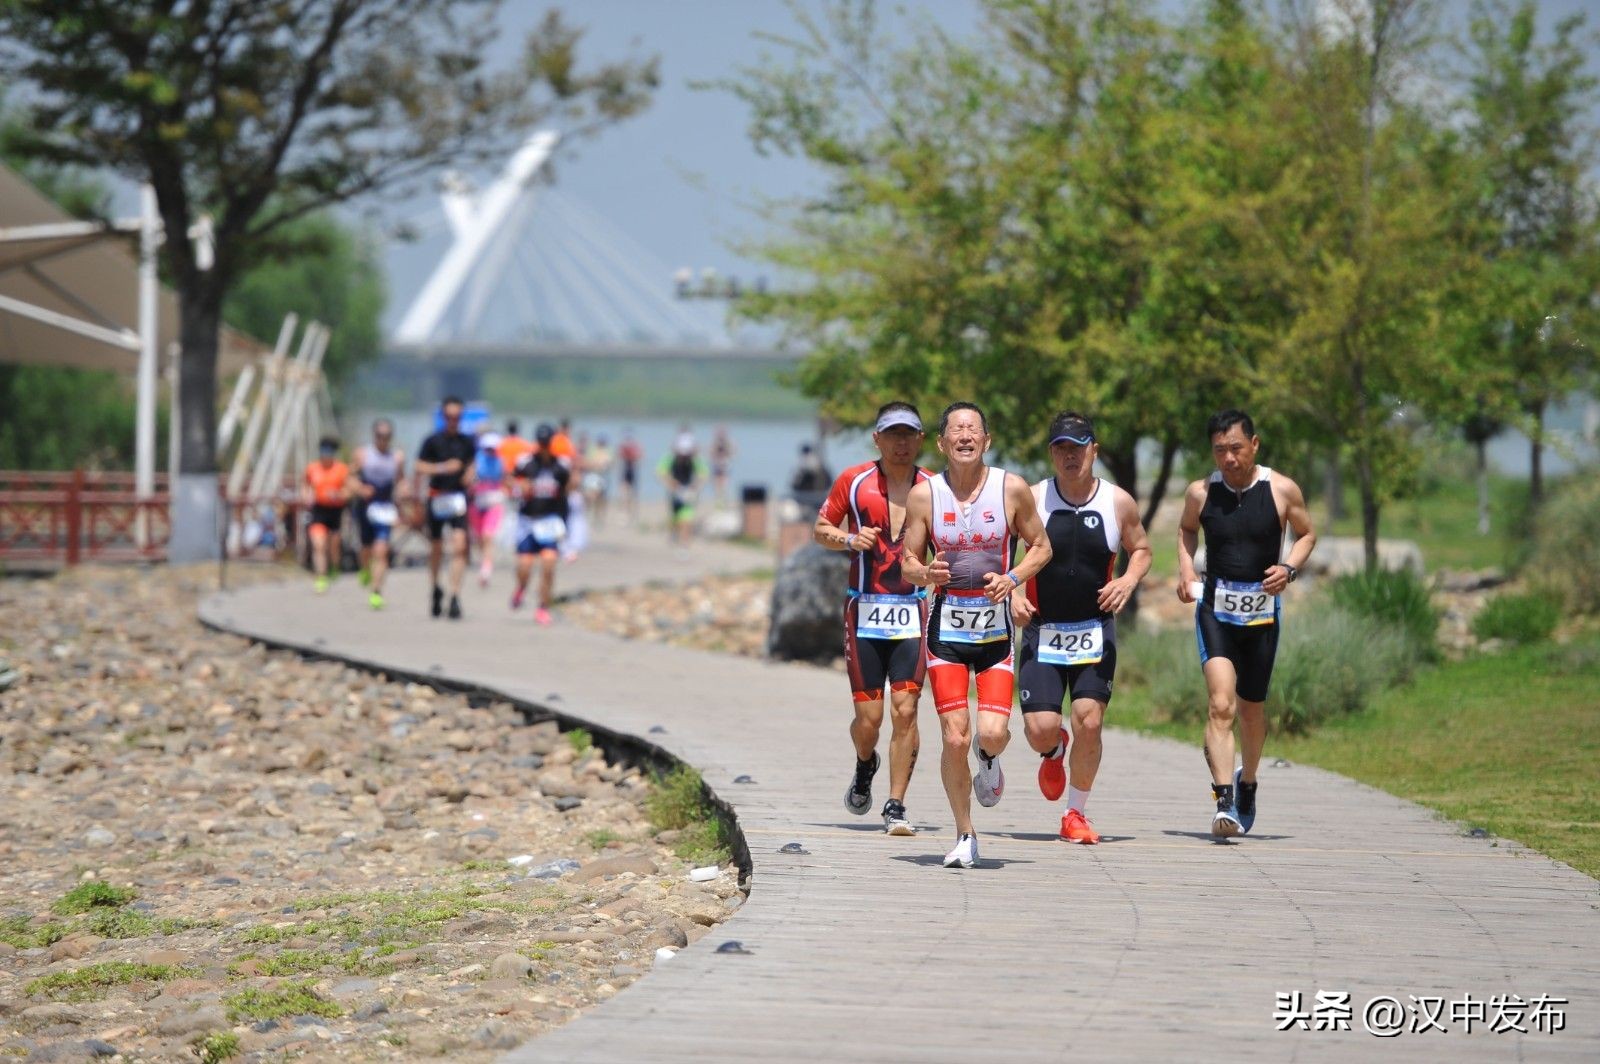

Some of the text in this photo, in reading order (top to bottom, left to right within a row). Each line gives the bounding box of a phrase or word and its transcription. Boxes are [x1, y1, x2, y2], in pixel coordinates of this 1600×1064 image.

[1224, 593, 1267, 613] 582
[868, 606, 911, 626] 440
[950, 609, 996, 630] 572
[1048, 632, 1094, 653] 426
